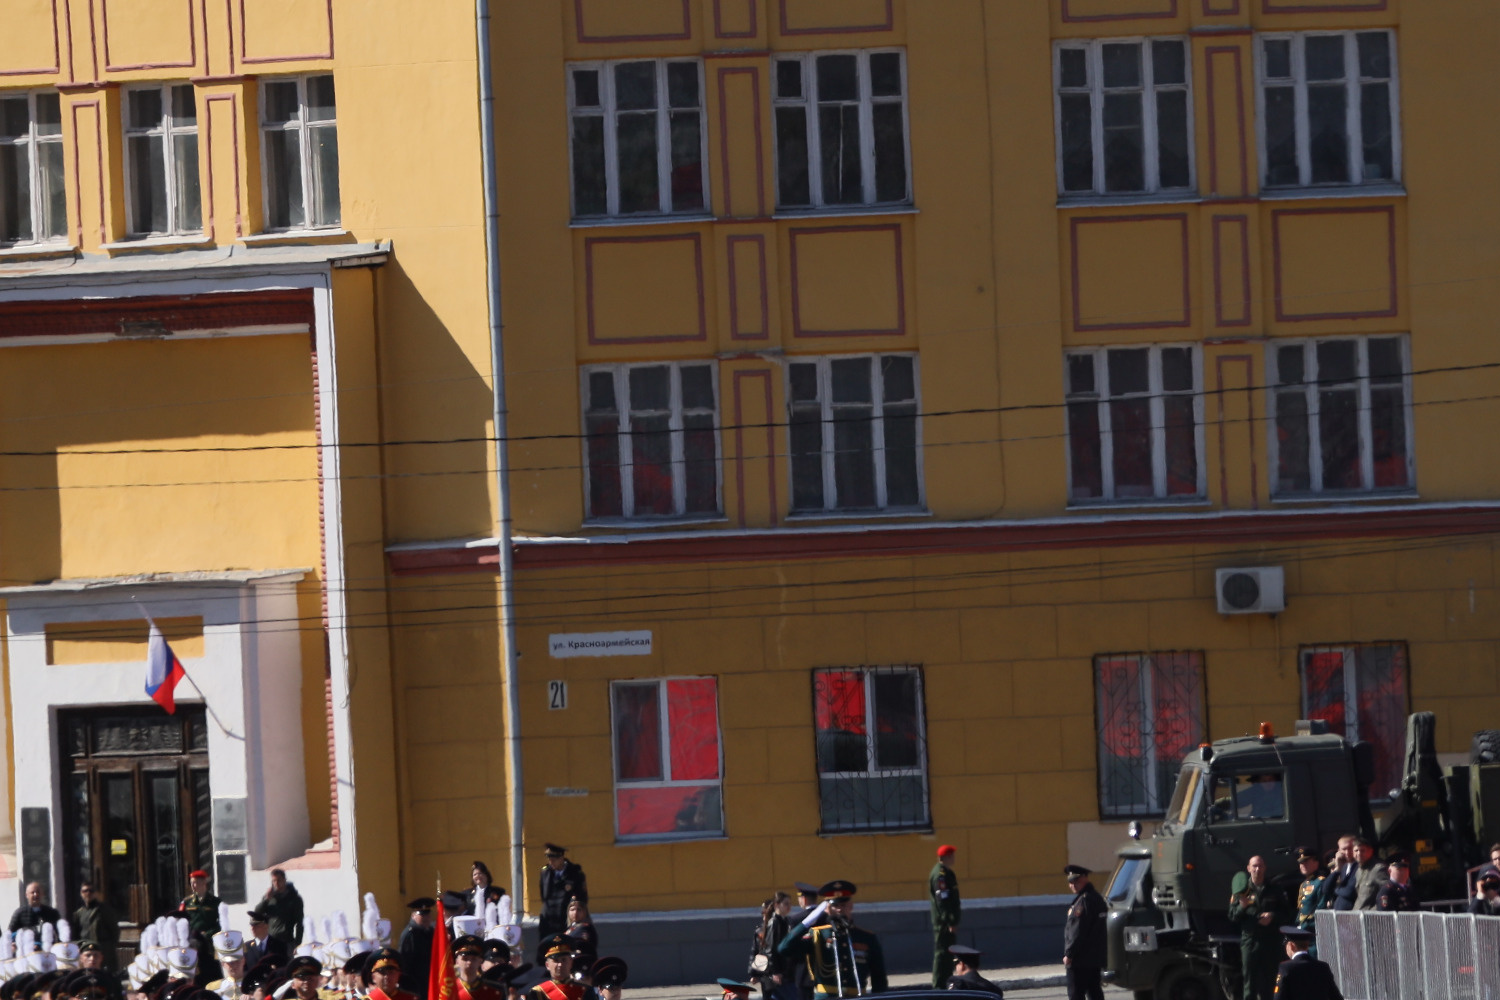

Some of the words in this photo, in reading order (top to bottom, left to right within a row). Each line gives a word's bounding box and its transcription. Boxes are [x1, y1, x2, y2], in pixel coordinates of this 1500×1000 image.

[553, 643, 566, 651] ул.
[568, 638, 650, 649] Красноармейская
[550, 681, 565, 708] 21
